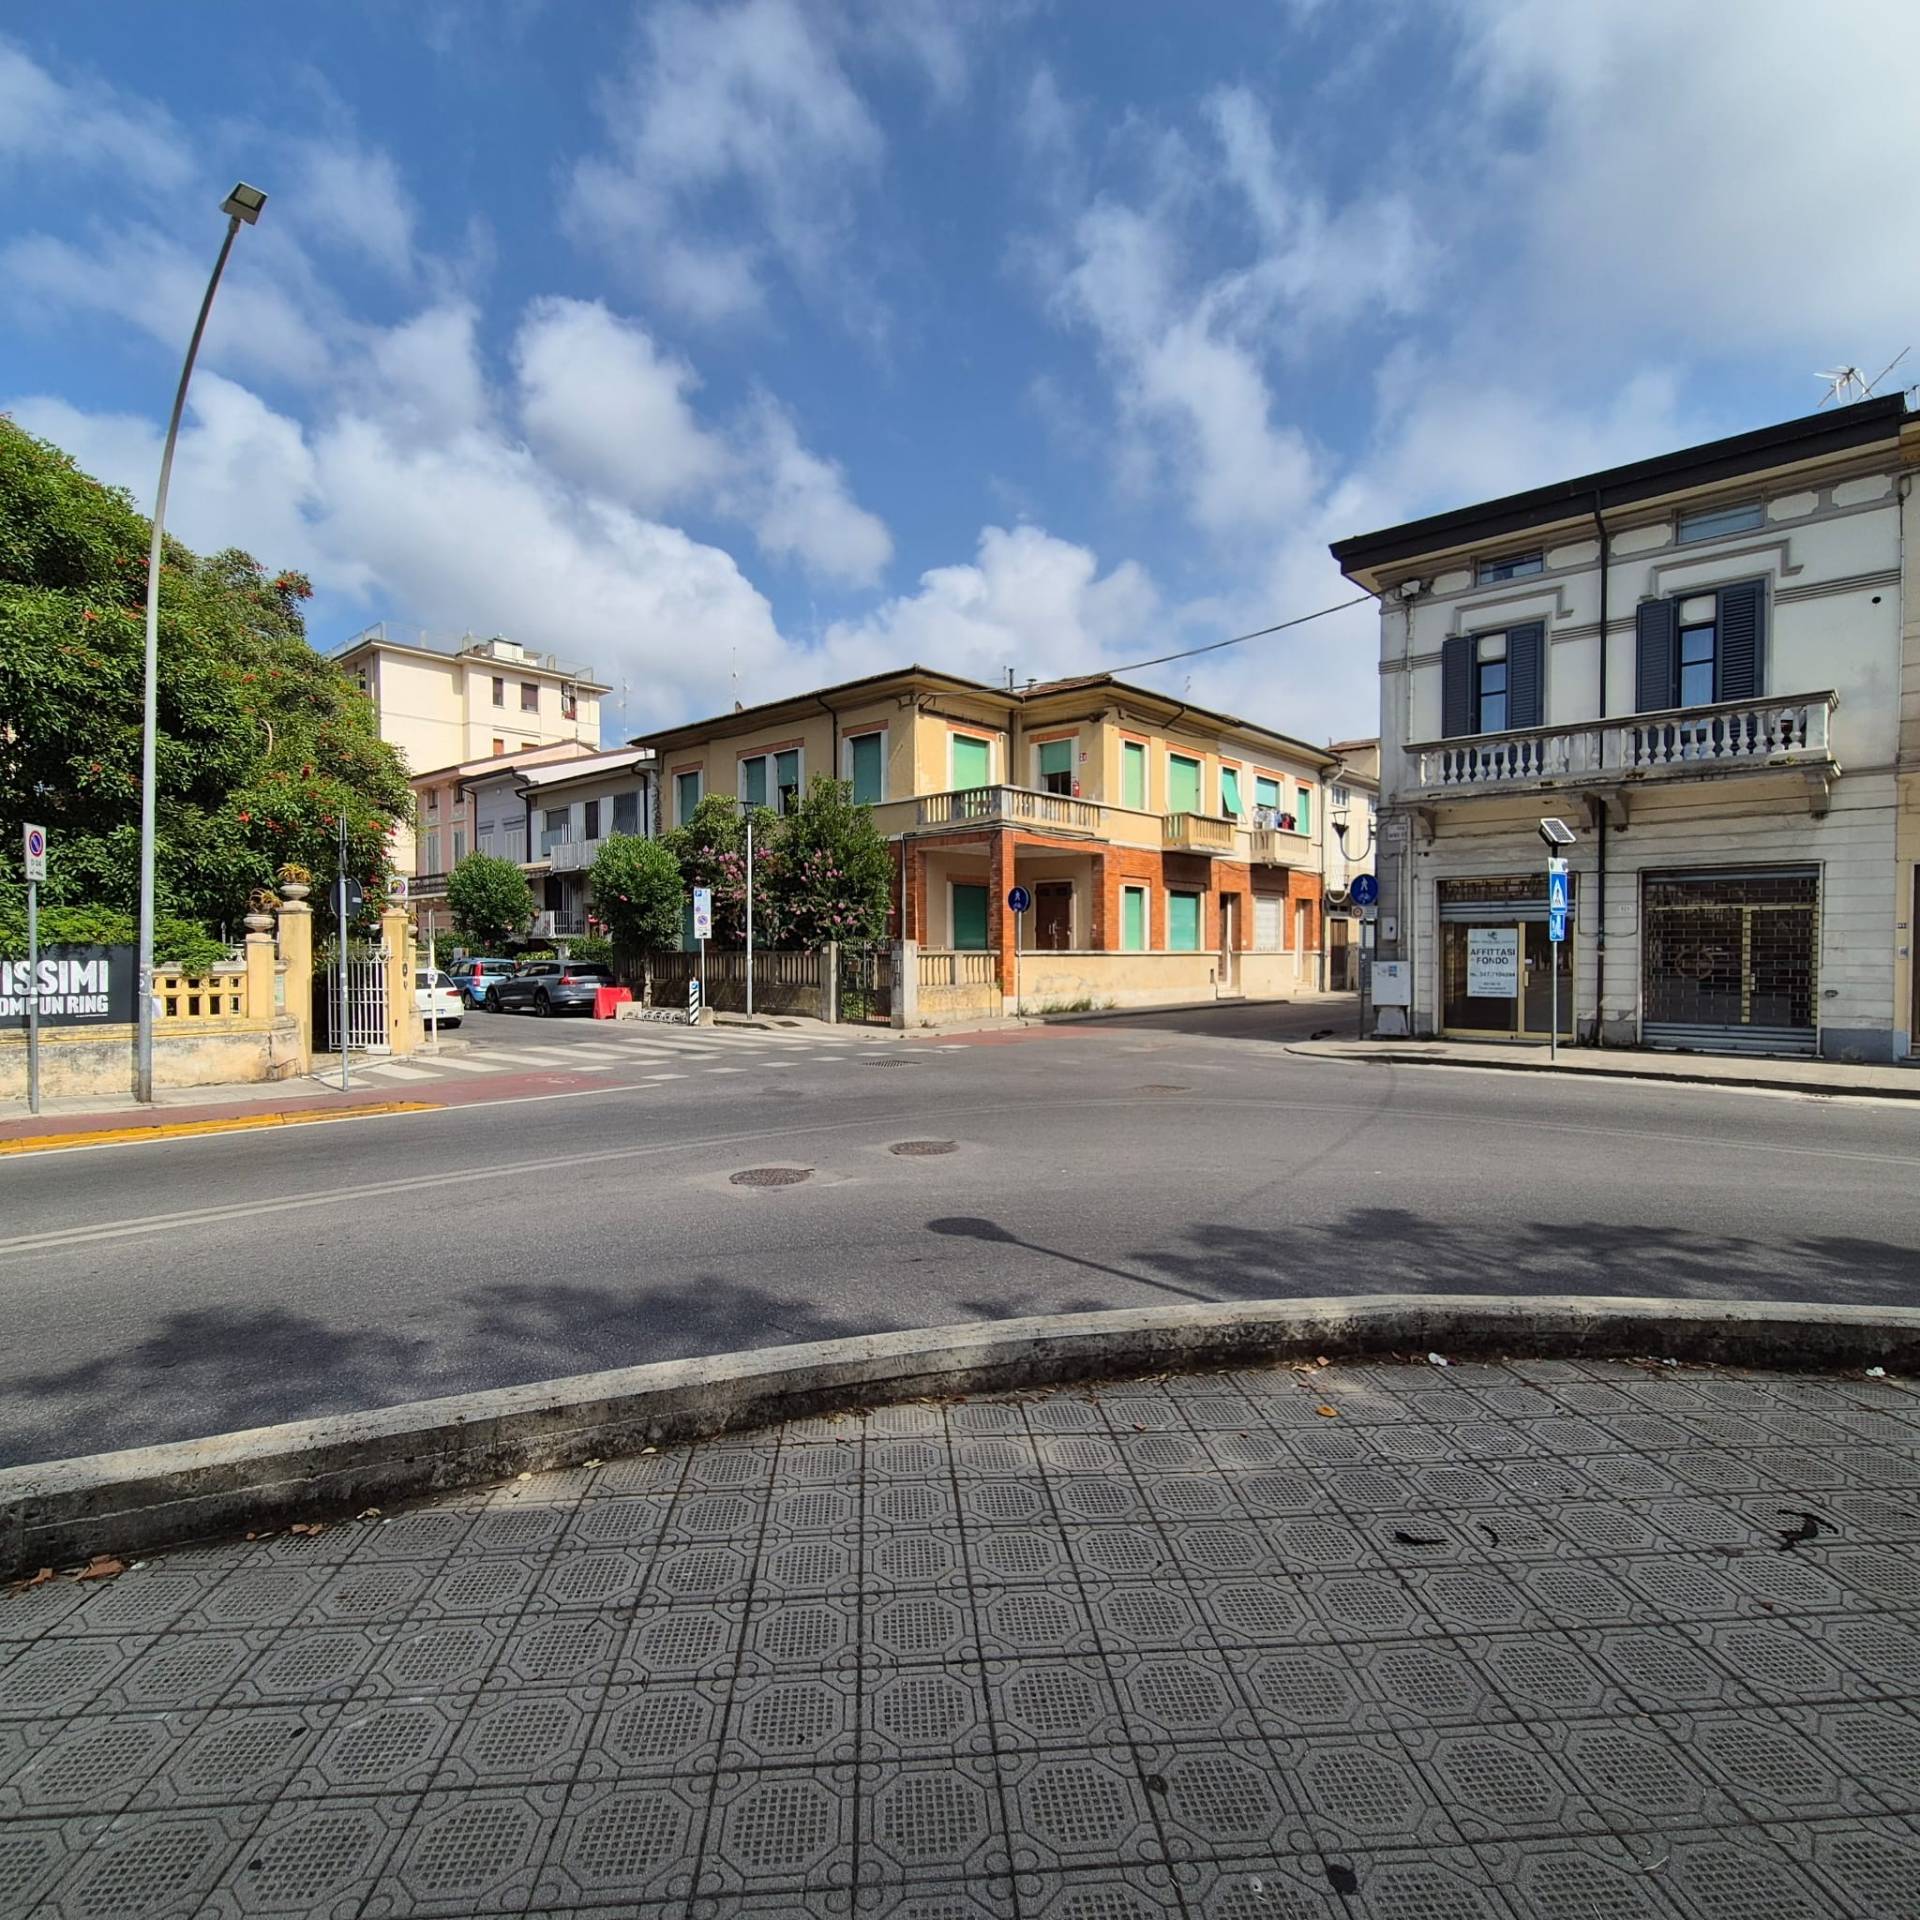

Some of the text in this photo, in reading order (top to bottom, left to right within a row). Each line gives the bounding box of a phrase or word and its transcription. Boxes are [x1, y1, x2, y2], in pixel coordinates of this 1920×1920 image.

[1470, 948, 1516, 956] AFFITTASI
[1476, 956, 1509, 965] FONDO
[0, 960, 109, 995] ISSIMI
[39, 995, 64, 1015] UN
[66, 994, 109, 1014] RING
